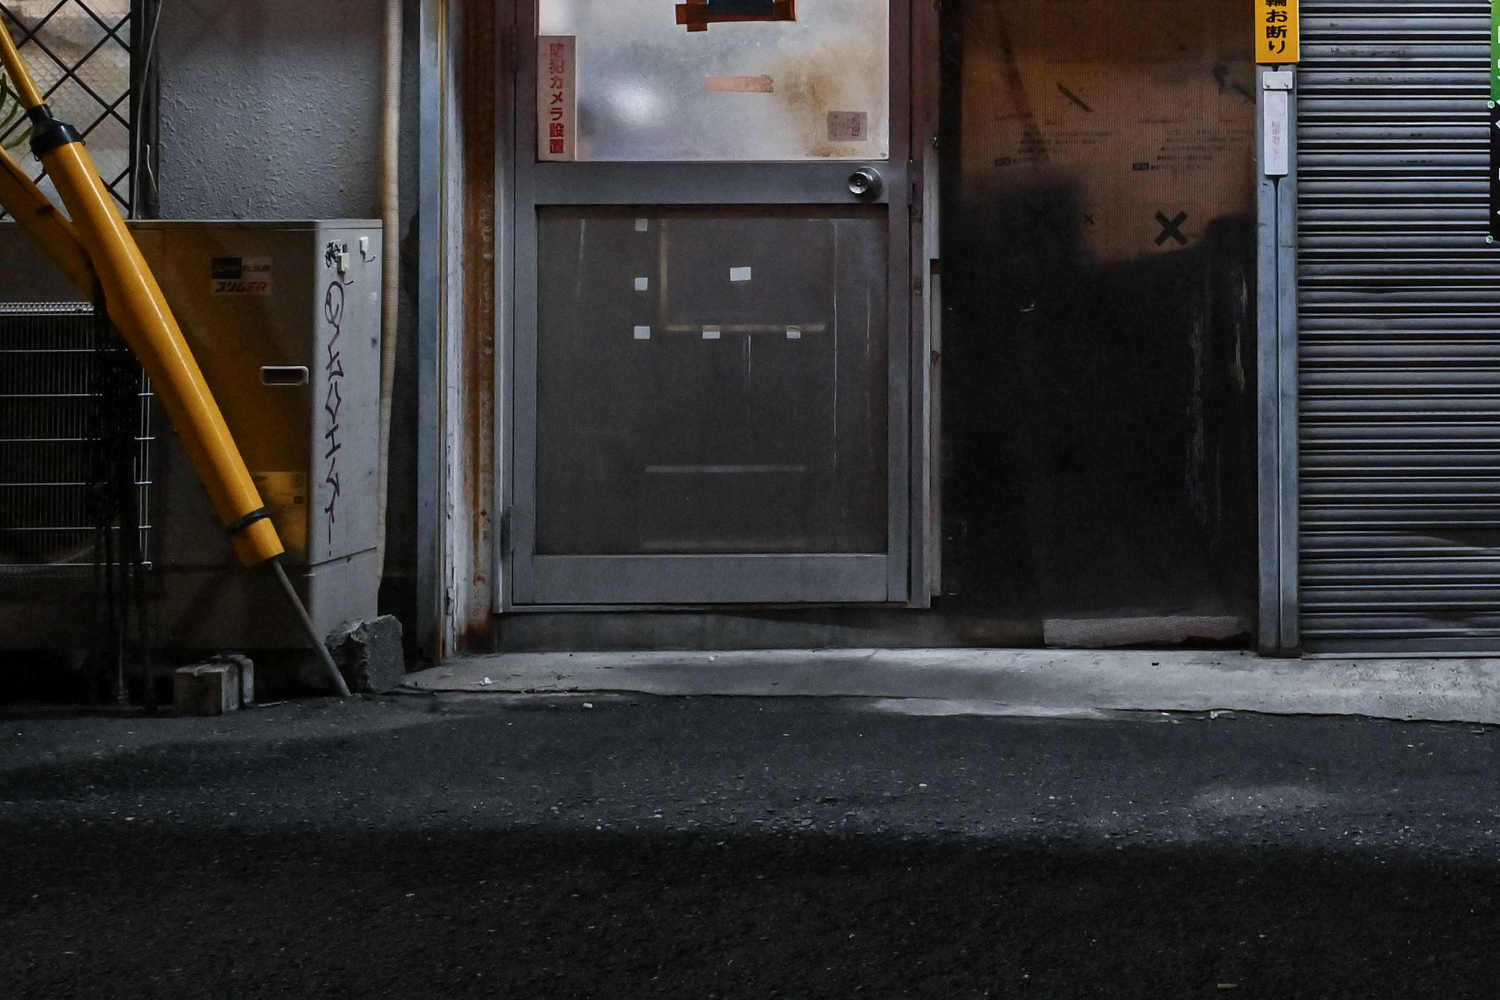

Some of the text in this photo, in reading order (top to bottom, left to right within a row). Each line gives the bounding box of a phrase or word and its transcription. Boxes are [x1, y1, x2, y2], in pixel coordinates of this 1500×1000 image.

[549, 42, 565, 154] 防犯カメラ設置
